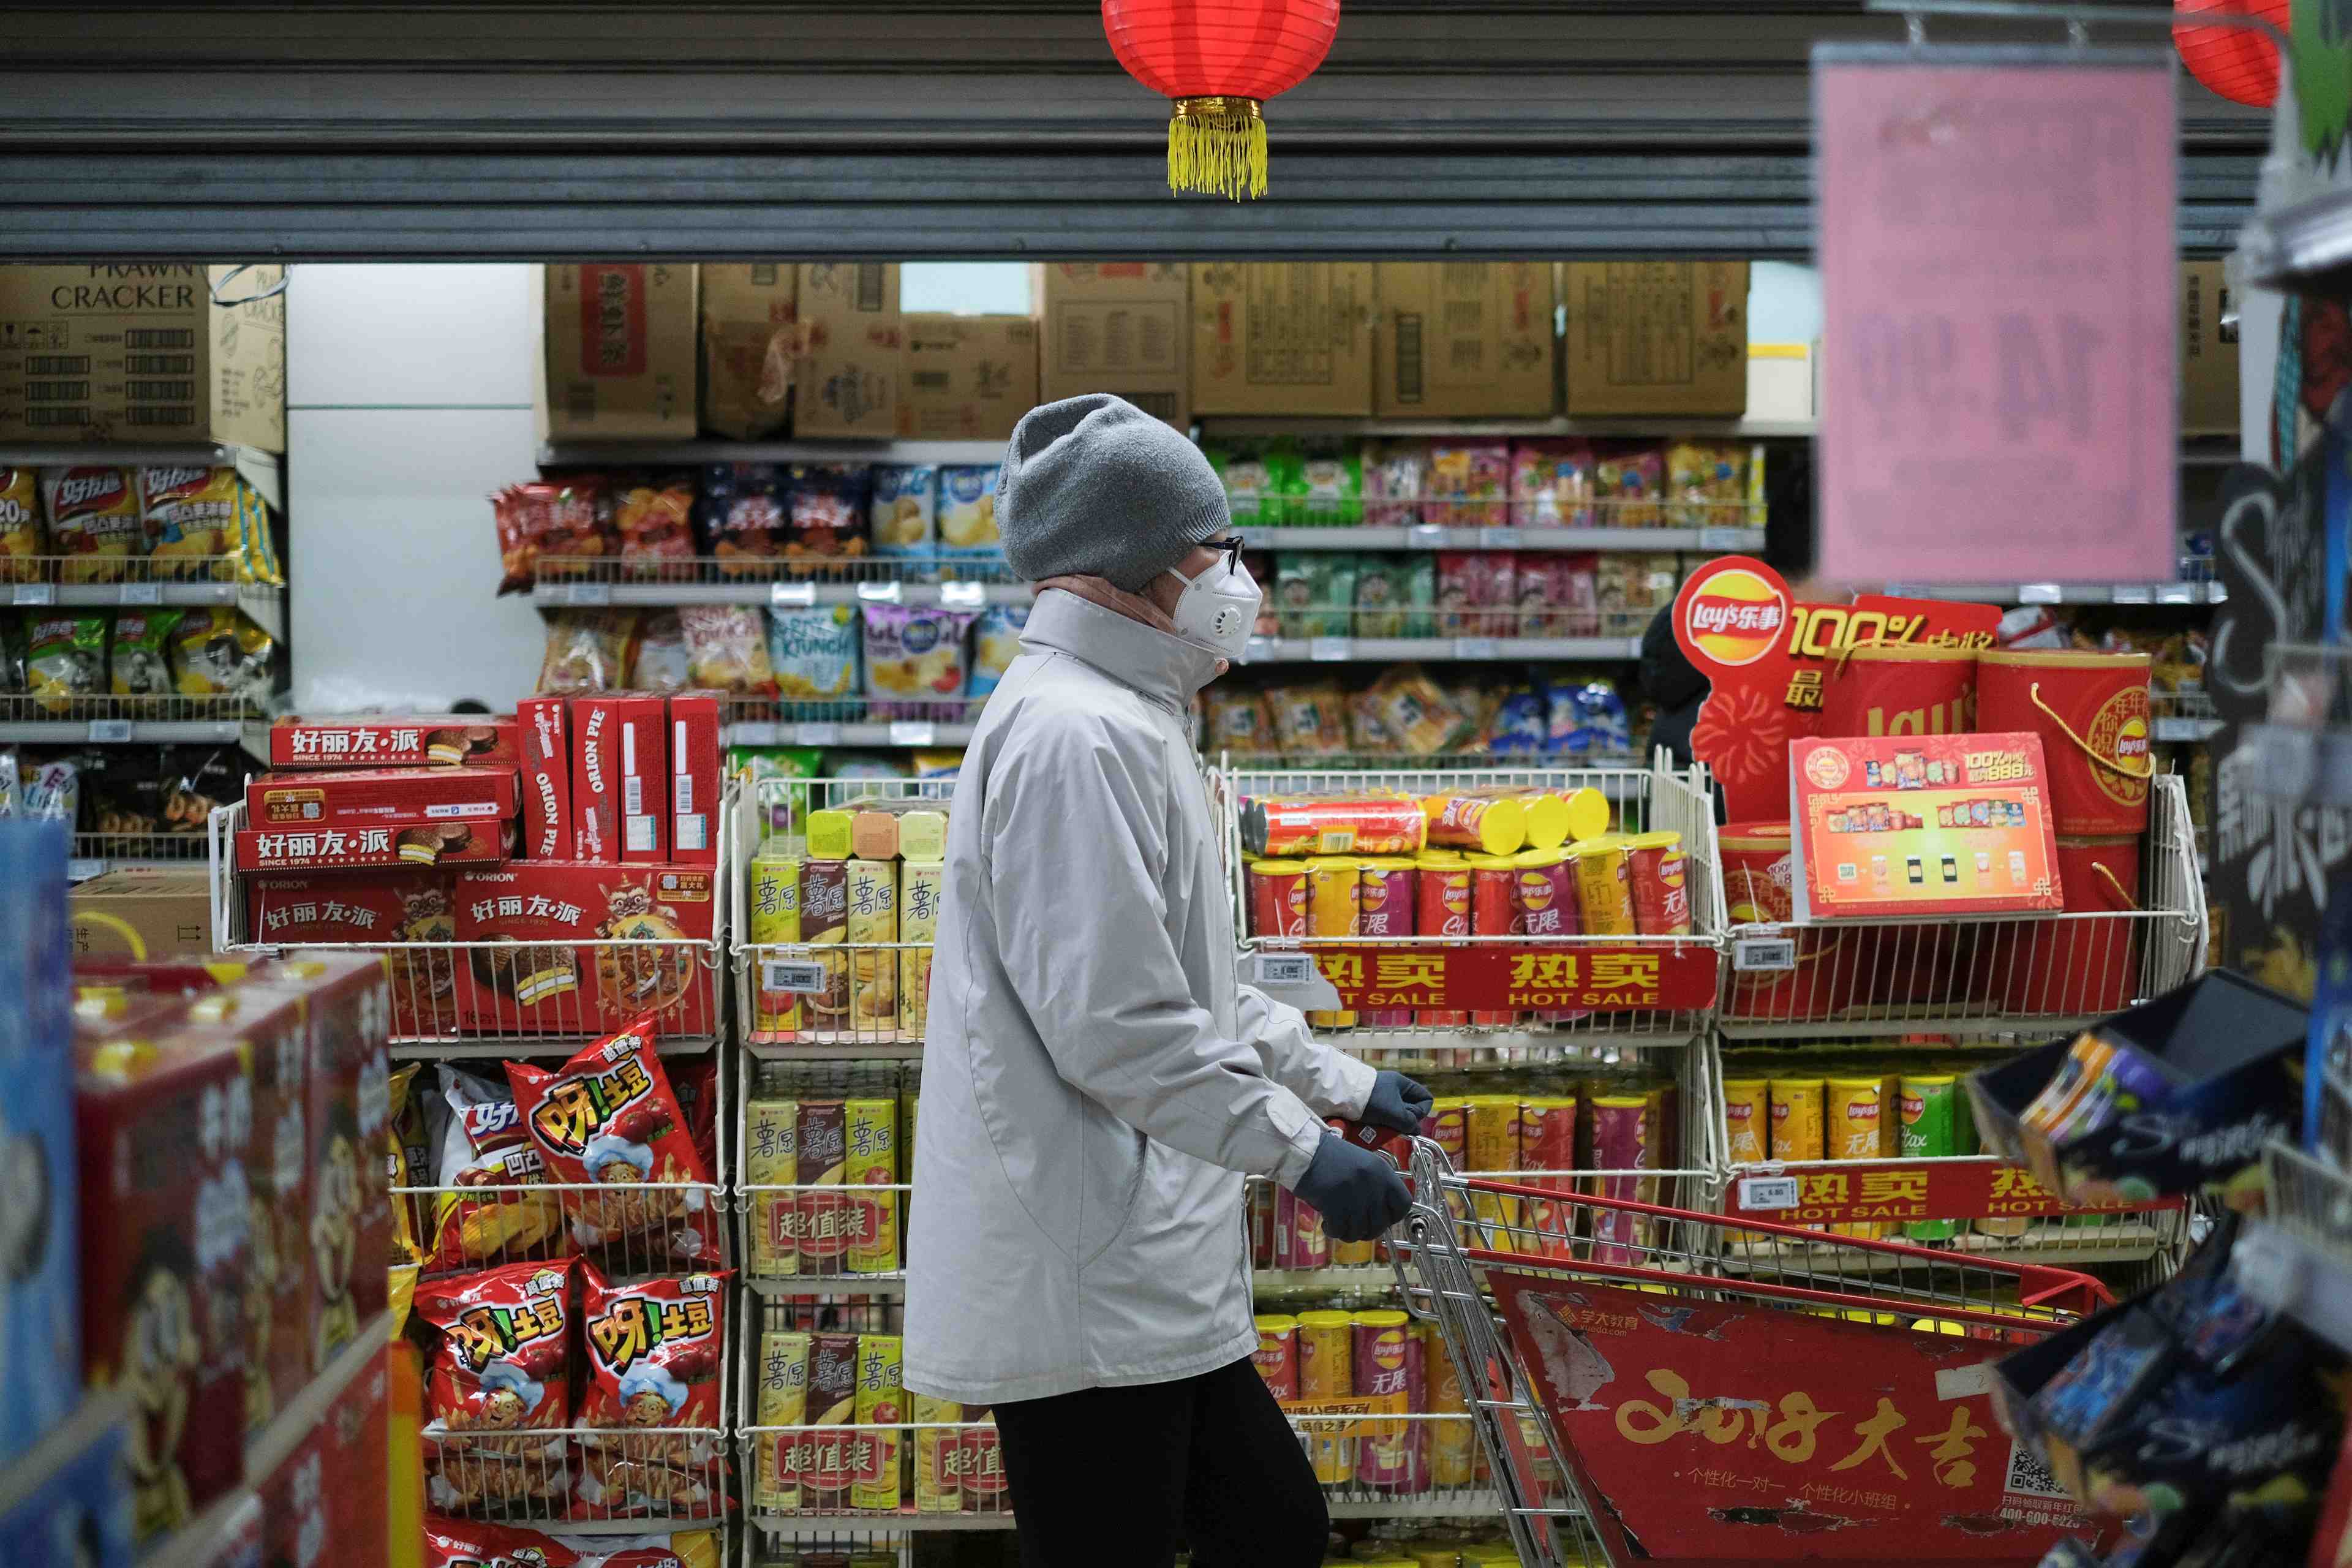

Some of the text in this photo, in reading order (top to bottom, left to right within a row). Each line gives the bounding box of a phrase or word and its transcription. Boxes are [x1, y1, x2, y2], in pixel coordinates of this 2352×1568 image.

[51, 285, 194, 307] CRACKER
[1785, 669, 1823, 710] 最
[586, 709, 606, 738] PIE
[585, 739, 605, 793] ORION
[536, 772, 559, 824] ORION
[540, 828, 558, 856] PIE
[271, 880, 307, 889] ORION
[475, 872, 516, 883] ORION
[1509, 953, 1660, 989] 热卖
[1368, 993, 1446, 1005] SALE
[1509, 993, 1659, 1005] HOT SALE
[1780, 1204, 1926, 1221] HOT SALE
[1988, 1200, 2047, 1213] HOT
[779, 1205, 870, 1242] 超值装
[1580, 1310, 1638, 1330] 学大教育
[783, 1441, 874, 1474] 超值装
[942, 1446, 1005, 1478] 超值
[1798, 1482, 1897, 1510] 个性化小班组
